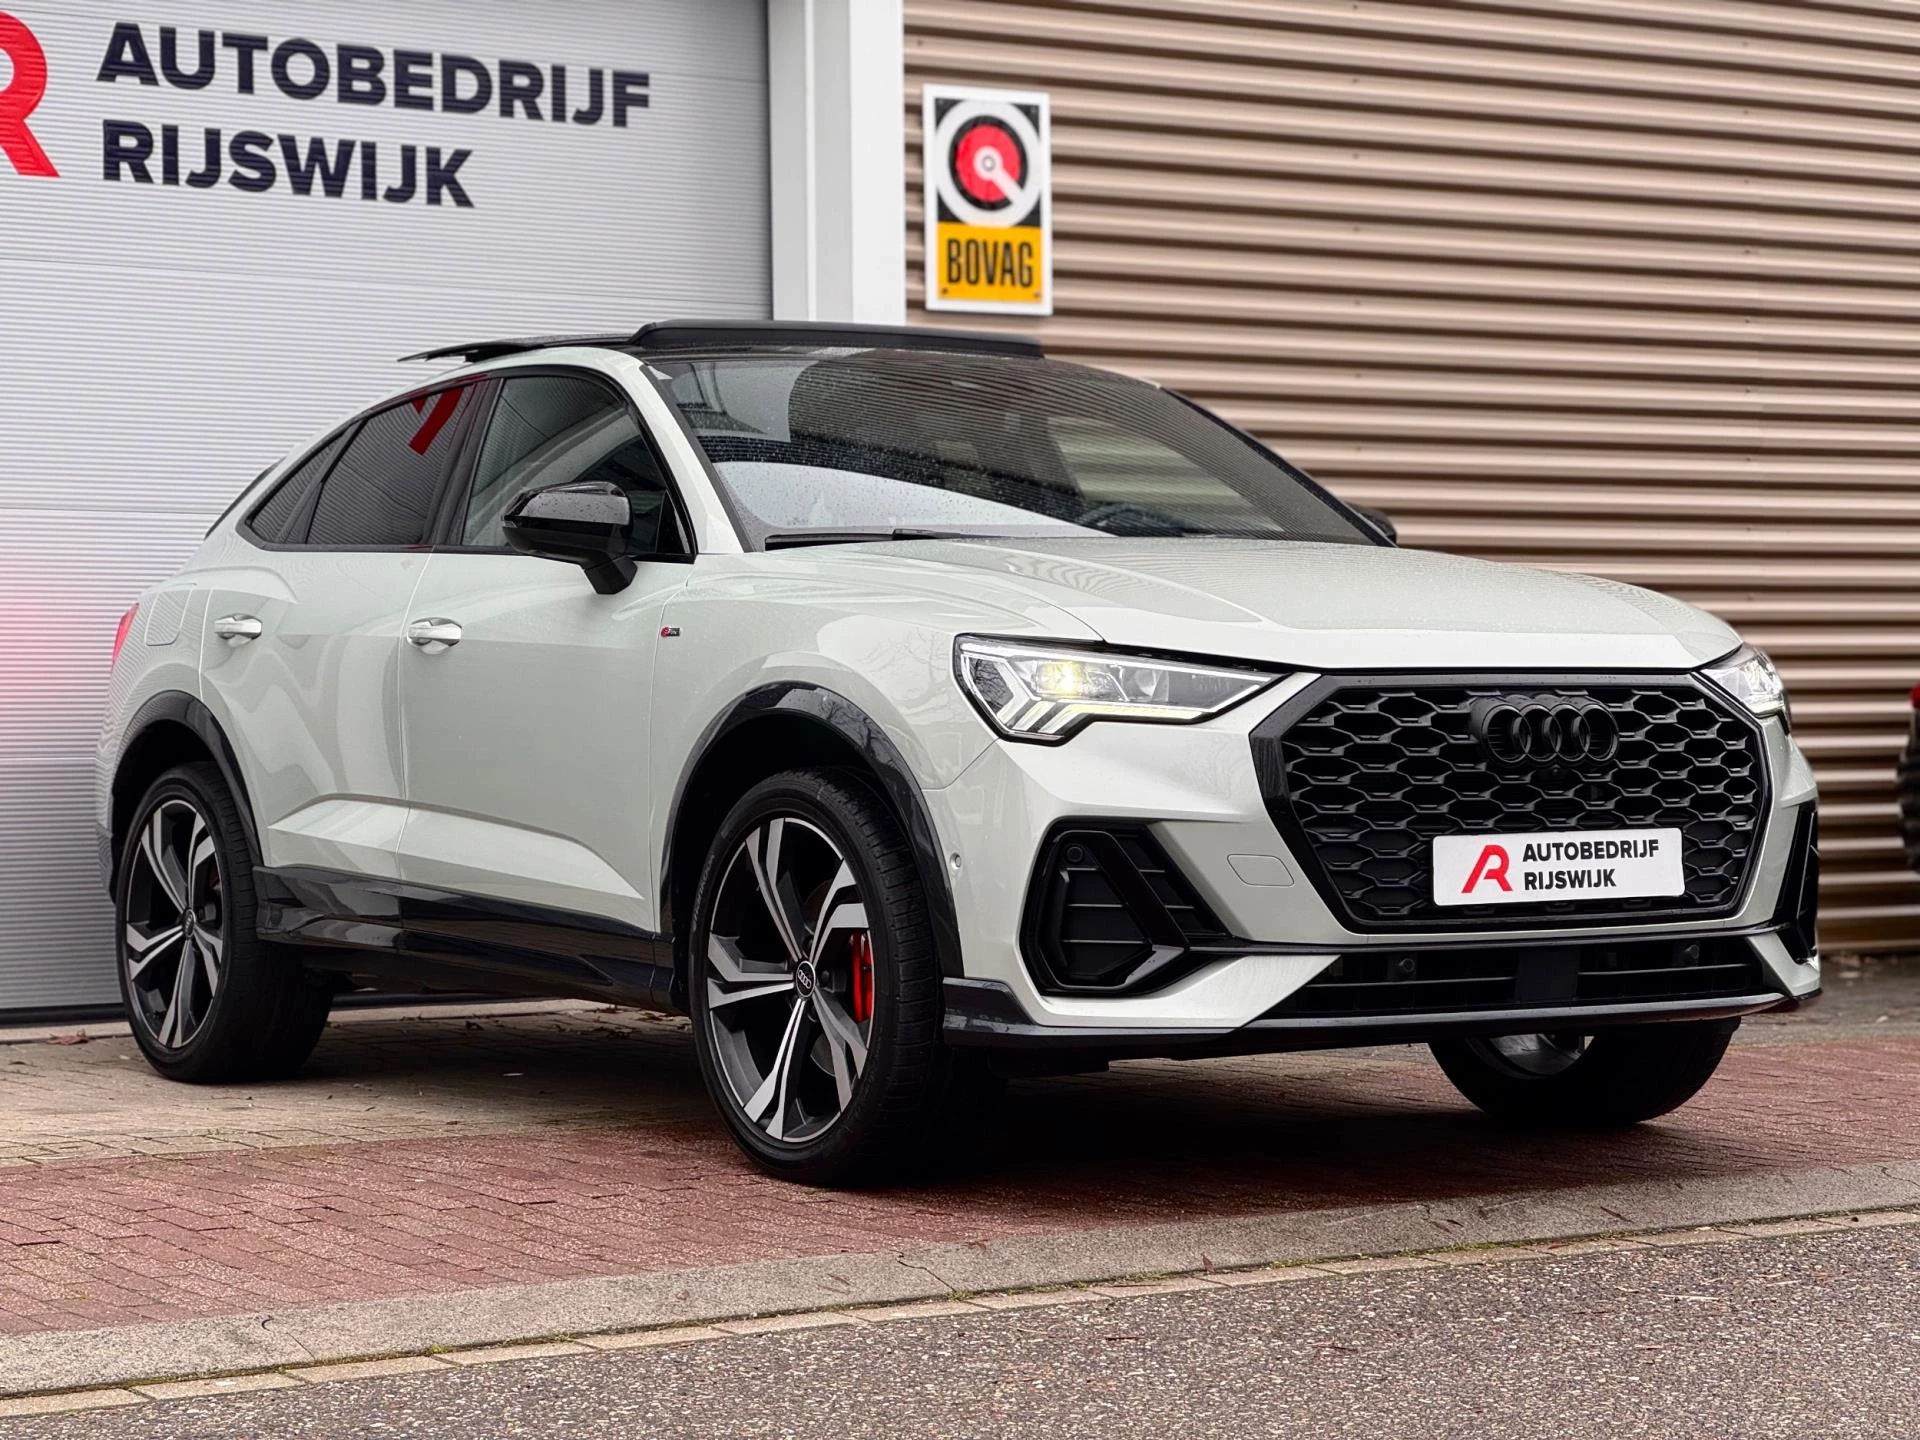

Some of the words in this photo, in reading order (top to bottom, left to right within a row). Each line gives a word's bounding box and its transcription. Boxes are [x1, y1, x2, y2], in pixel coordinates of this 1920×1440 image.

[97, 22, 650, 128] AUTOBEDRIJF
[102, 119, 475, 208] RIJSWIJK
[947, 238, 1033, 287] BOVAG
[1522, 839, 1659, 862] AUTOBEDRIJF
[1524, 869, 1616, 891] RIJSWIJK
